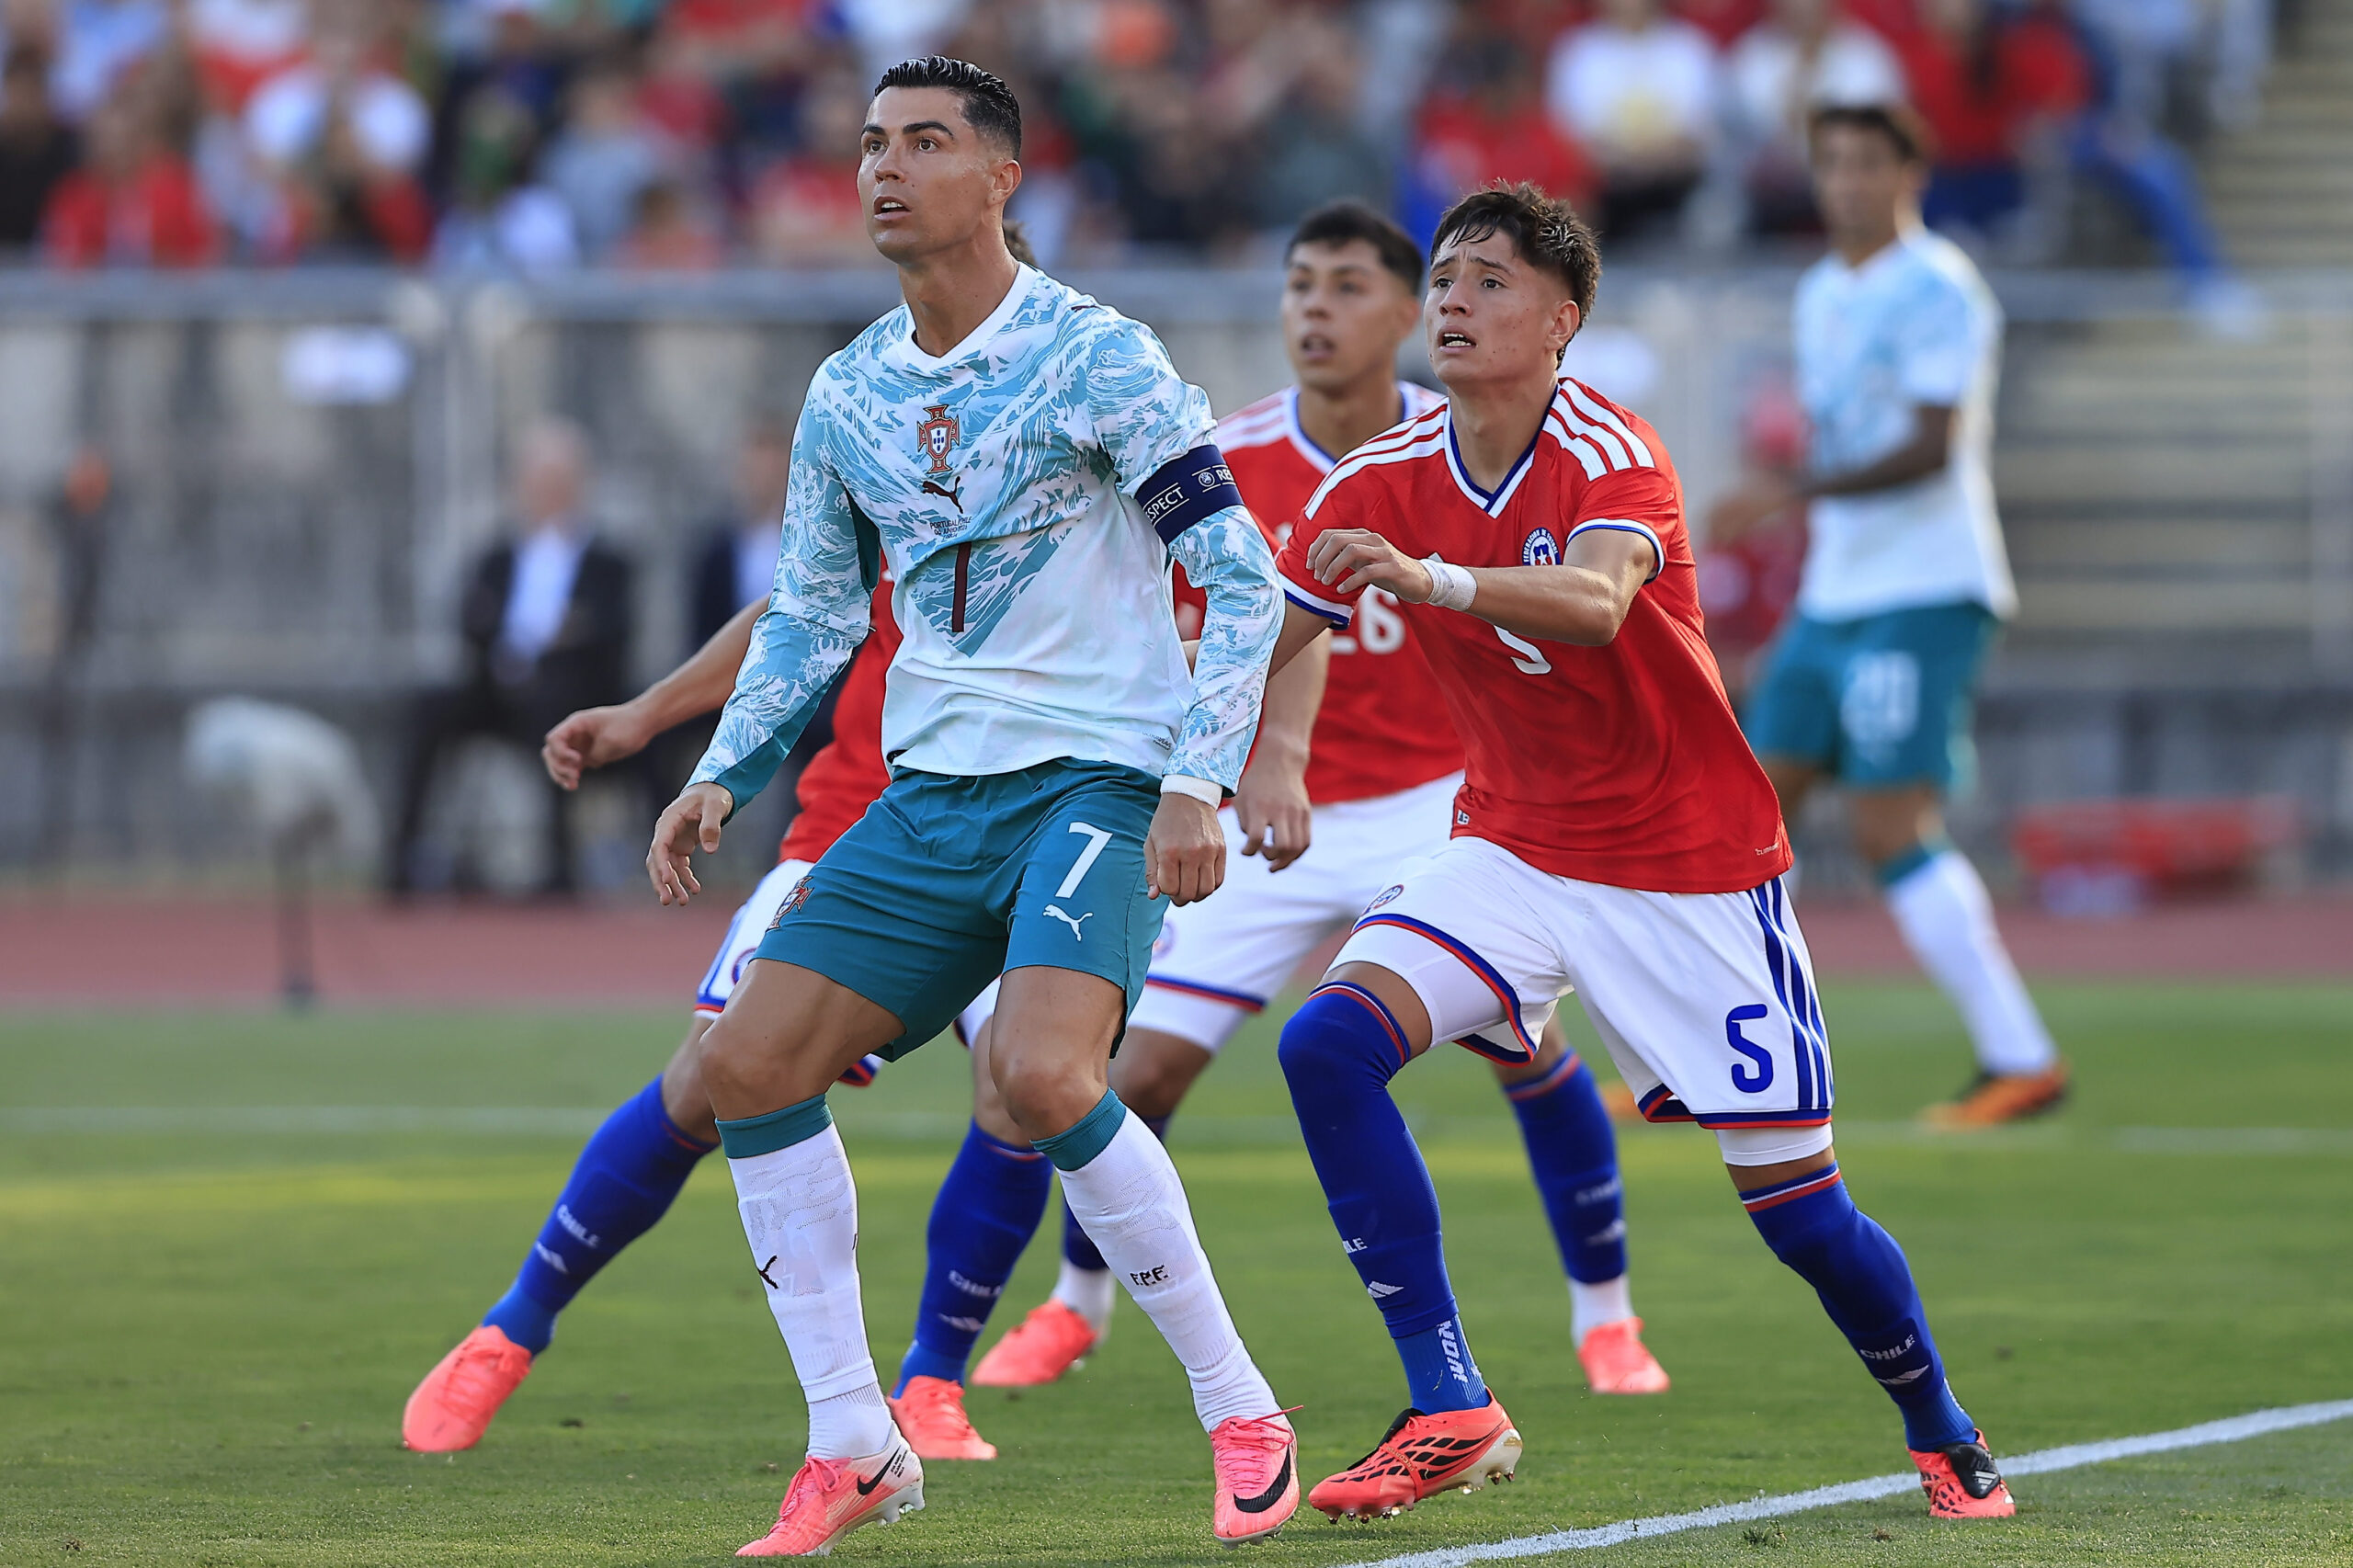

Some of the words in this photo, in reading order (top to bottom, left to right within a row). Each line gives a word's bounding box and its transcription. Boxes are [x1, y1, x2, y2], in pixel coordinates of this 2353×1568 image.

[1145, 486, 1184, 521] SPECT
[1054, 821, 1113, 899] 7
[1725, 1003, 1774, 1094] 5
[1859, 1334, 1915, 1360] CHILE
